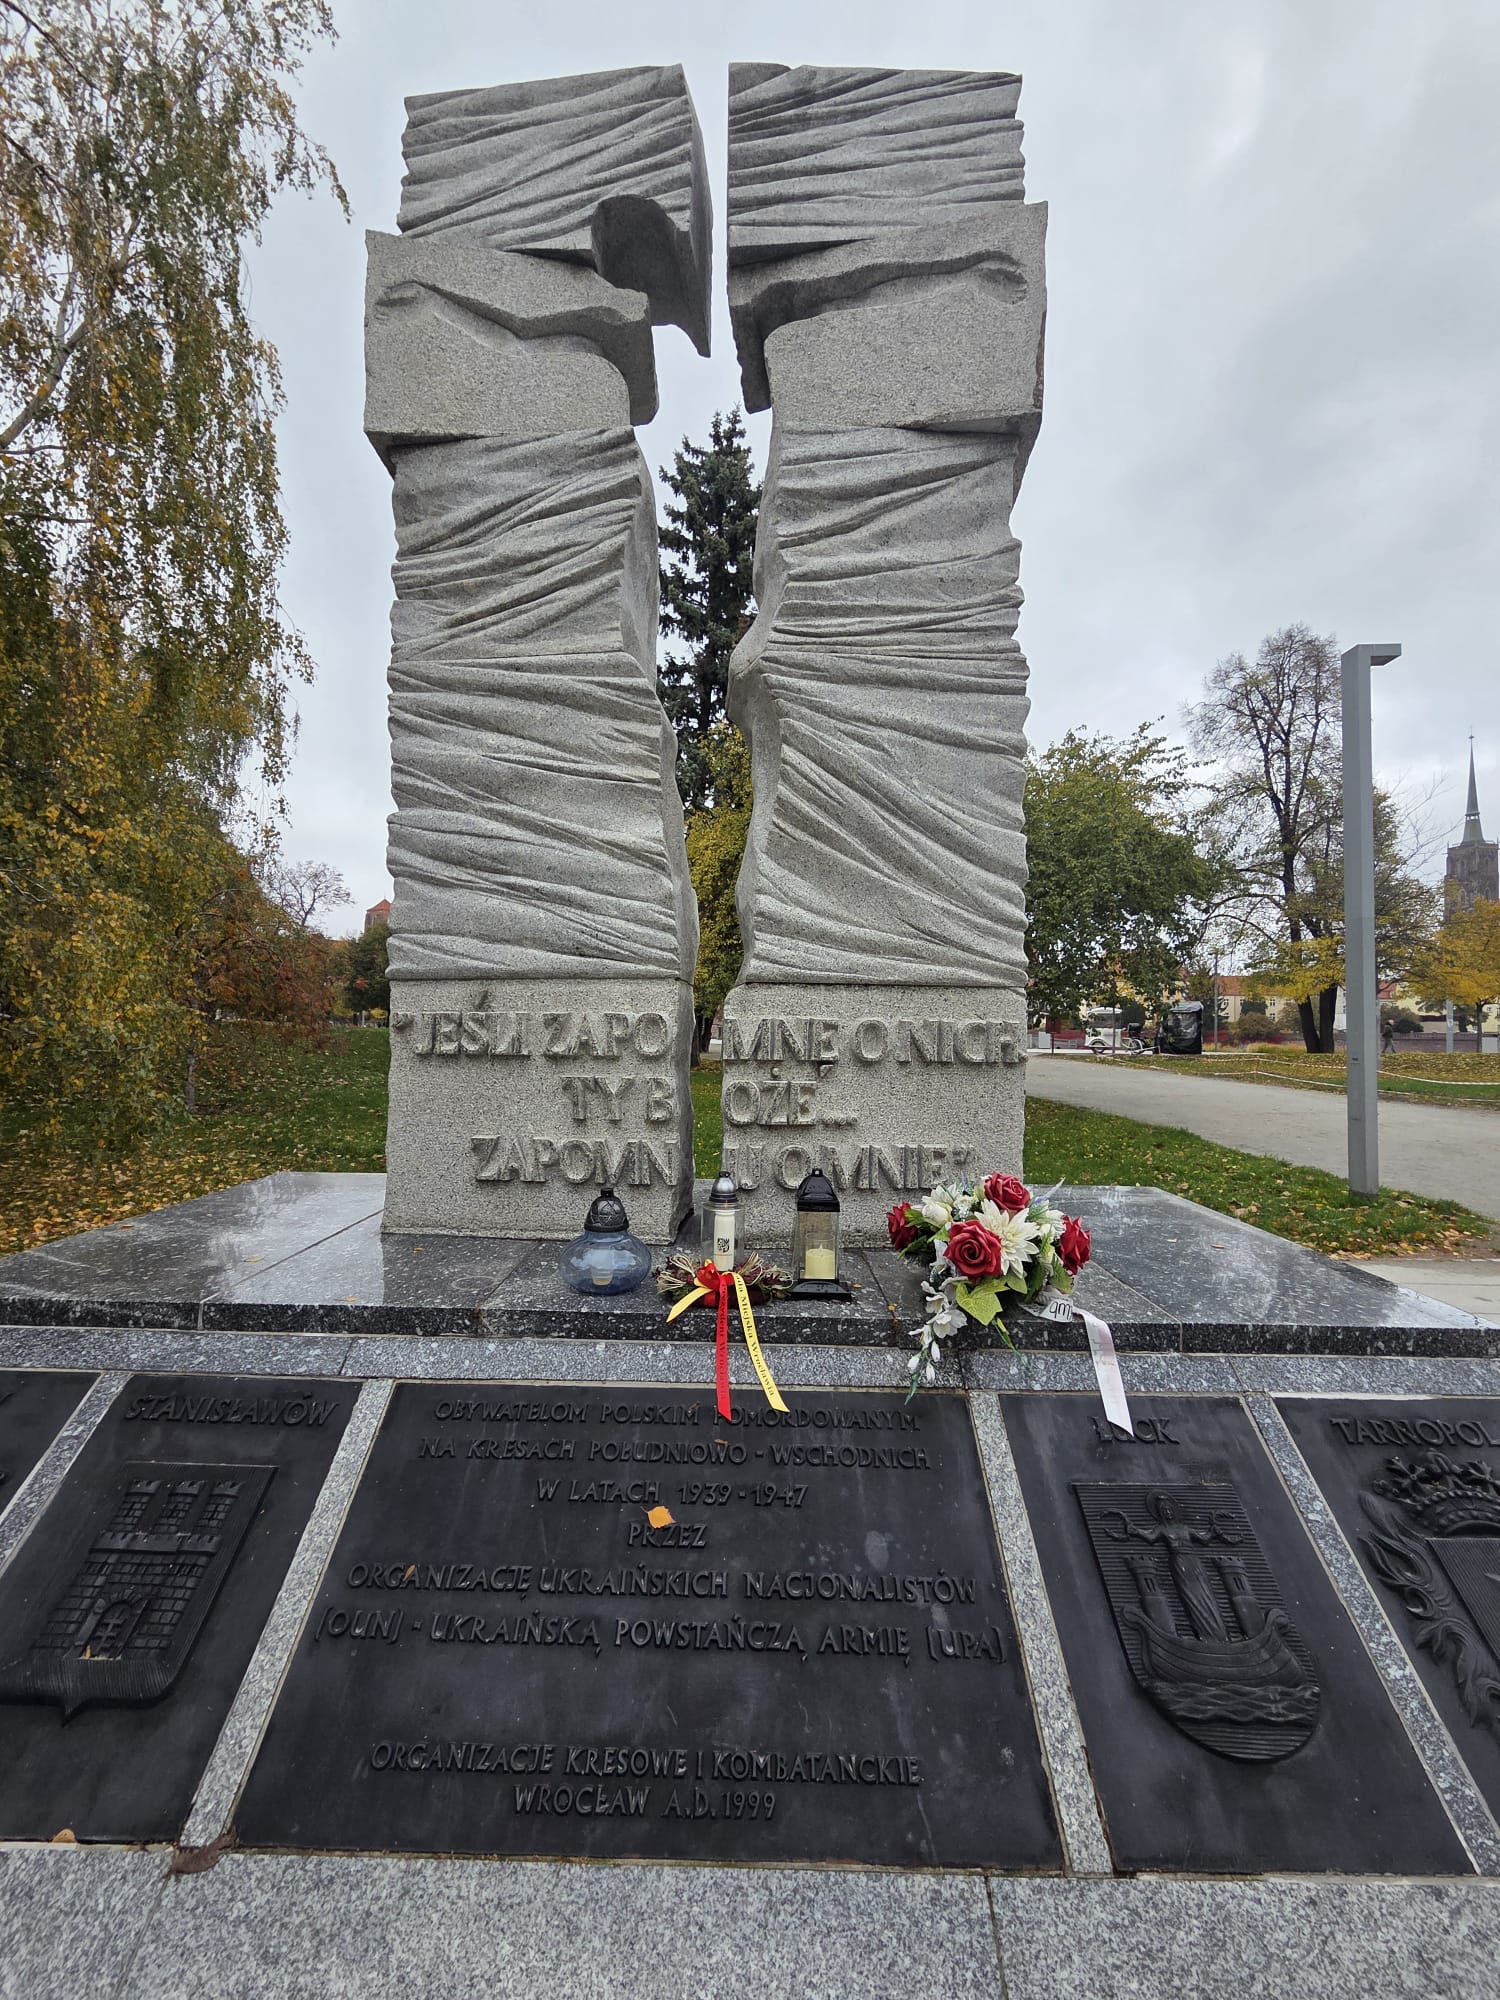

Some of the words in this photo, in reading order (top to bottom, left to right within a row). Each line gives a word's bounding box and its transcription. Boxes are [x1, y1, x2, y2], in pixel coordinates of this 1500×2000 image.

[541, 1010, 669, 1057] ZAPO
[722, 1017, 839, 1077] MNĘ
[854, 1018, 889, 1062] O
[561, 1076, 634, 1121] TY
[647, 1076, 674, 1122] B
[470, 1134, 678, 1186] ZAPOMN
[776, 1144, 811, 1190] O
[740, 1296, 753, 1338] Miejska
[124, 1392, 340, 1426] STANISŁAWÓW
[434, 1400, 590, 1422] OBYWATELOM
[600, 1402, 699, 1426] POLSKIM
[418, 1436, 456, 1458] NA
[466, 1438, 576, 1460] KRESACH
[588, 1440, 747, 1465] POŁUDNIOWO
[770, 1443, 931, 1469] WSCHODNICH
[537, 1477, 562, 1500] W
[568, 1478, 661, 1504] LATACH
[628, 1521, 708, 1549] PRZEZ
[347, 1561, 534, 1601] ORGANIZACJĘ
[537, 1560, 729, 1598] UKRAIŃSKICH
[743, 1567, 978, 1605] NACJONALISTÓW
[430, 1609, 602, 1657] UKRAIŃSKĄ
[613, 1613, 808, 1663] POWSTAŃCZĄ
[816, 1623, 914, 1669] ARMIĘ
[370, 1739, 553, 1773] ORGANIZACJE
[564, 1745, 688, 1777] KRESOWE
[696, 1750, 704, 1778] I
[712, 1750, 922, 1786] KOMBATANCKIE
[513, 1782, 652, 1817] WROCŁAW
[660, 1788, 716, 1819] A.D.
[720, 1790, 777, 1821] 1999
